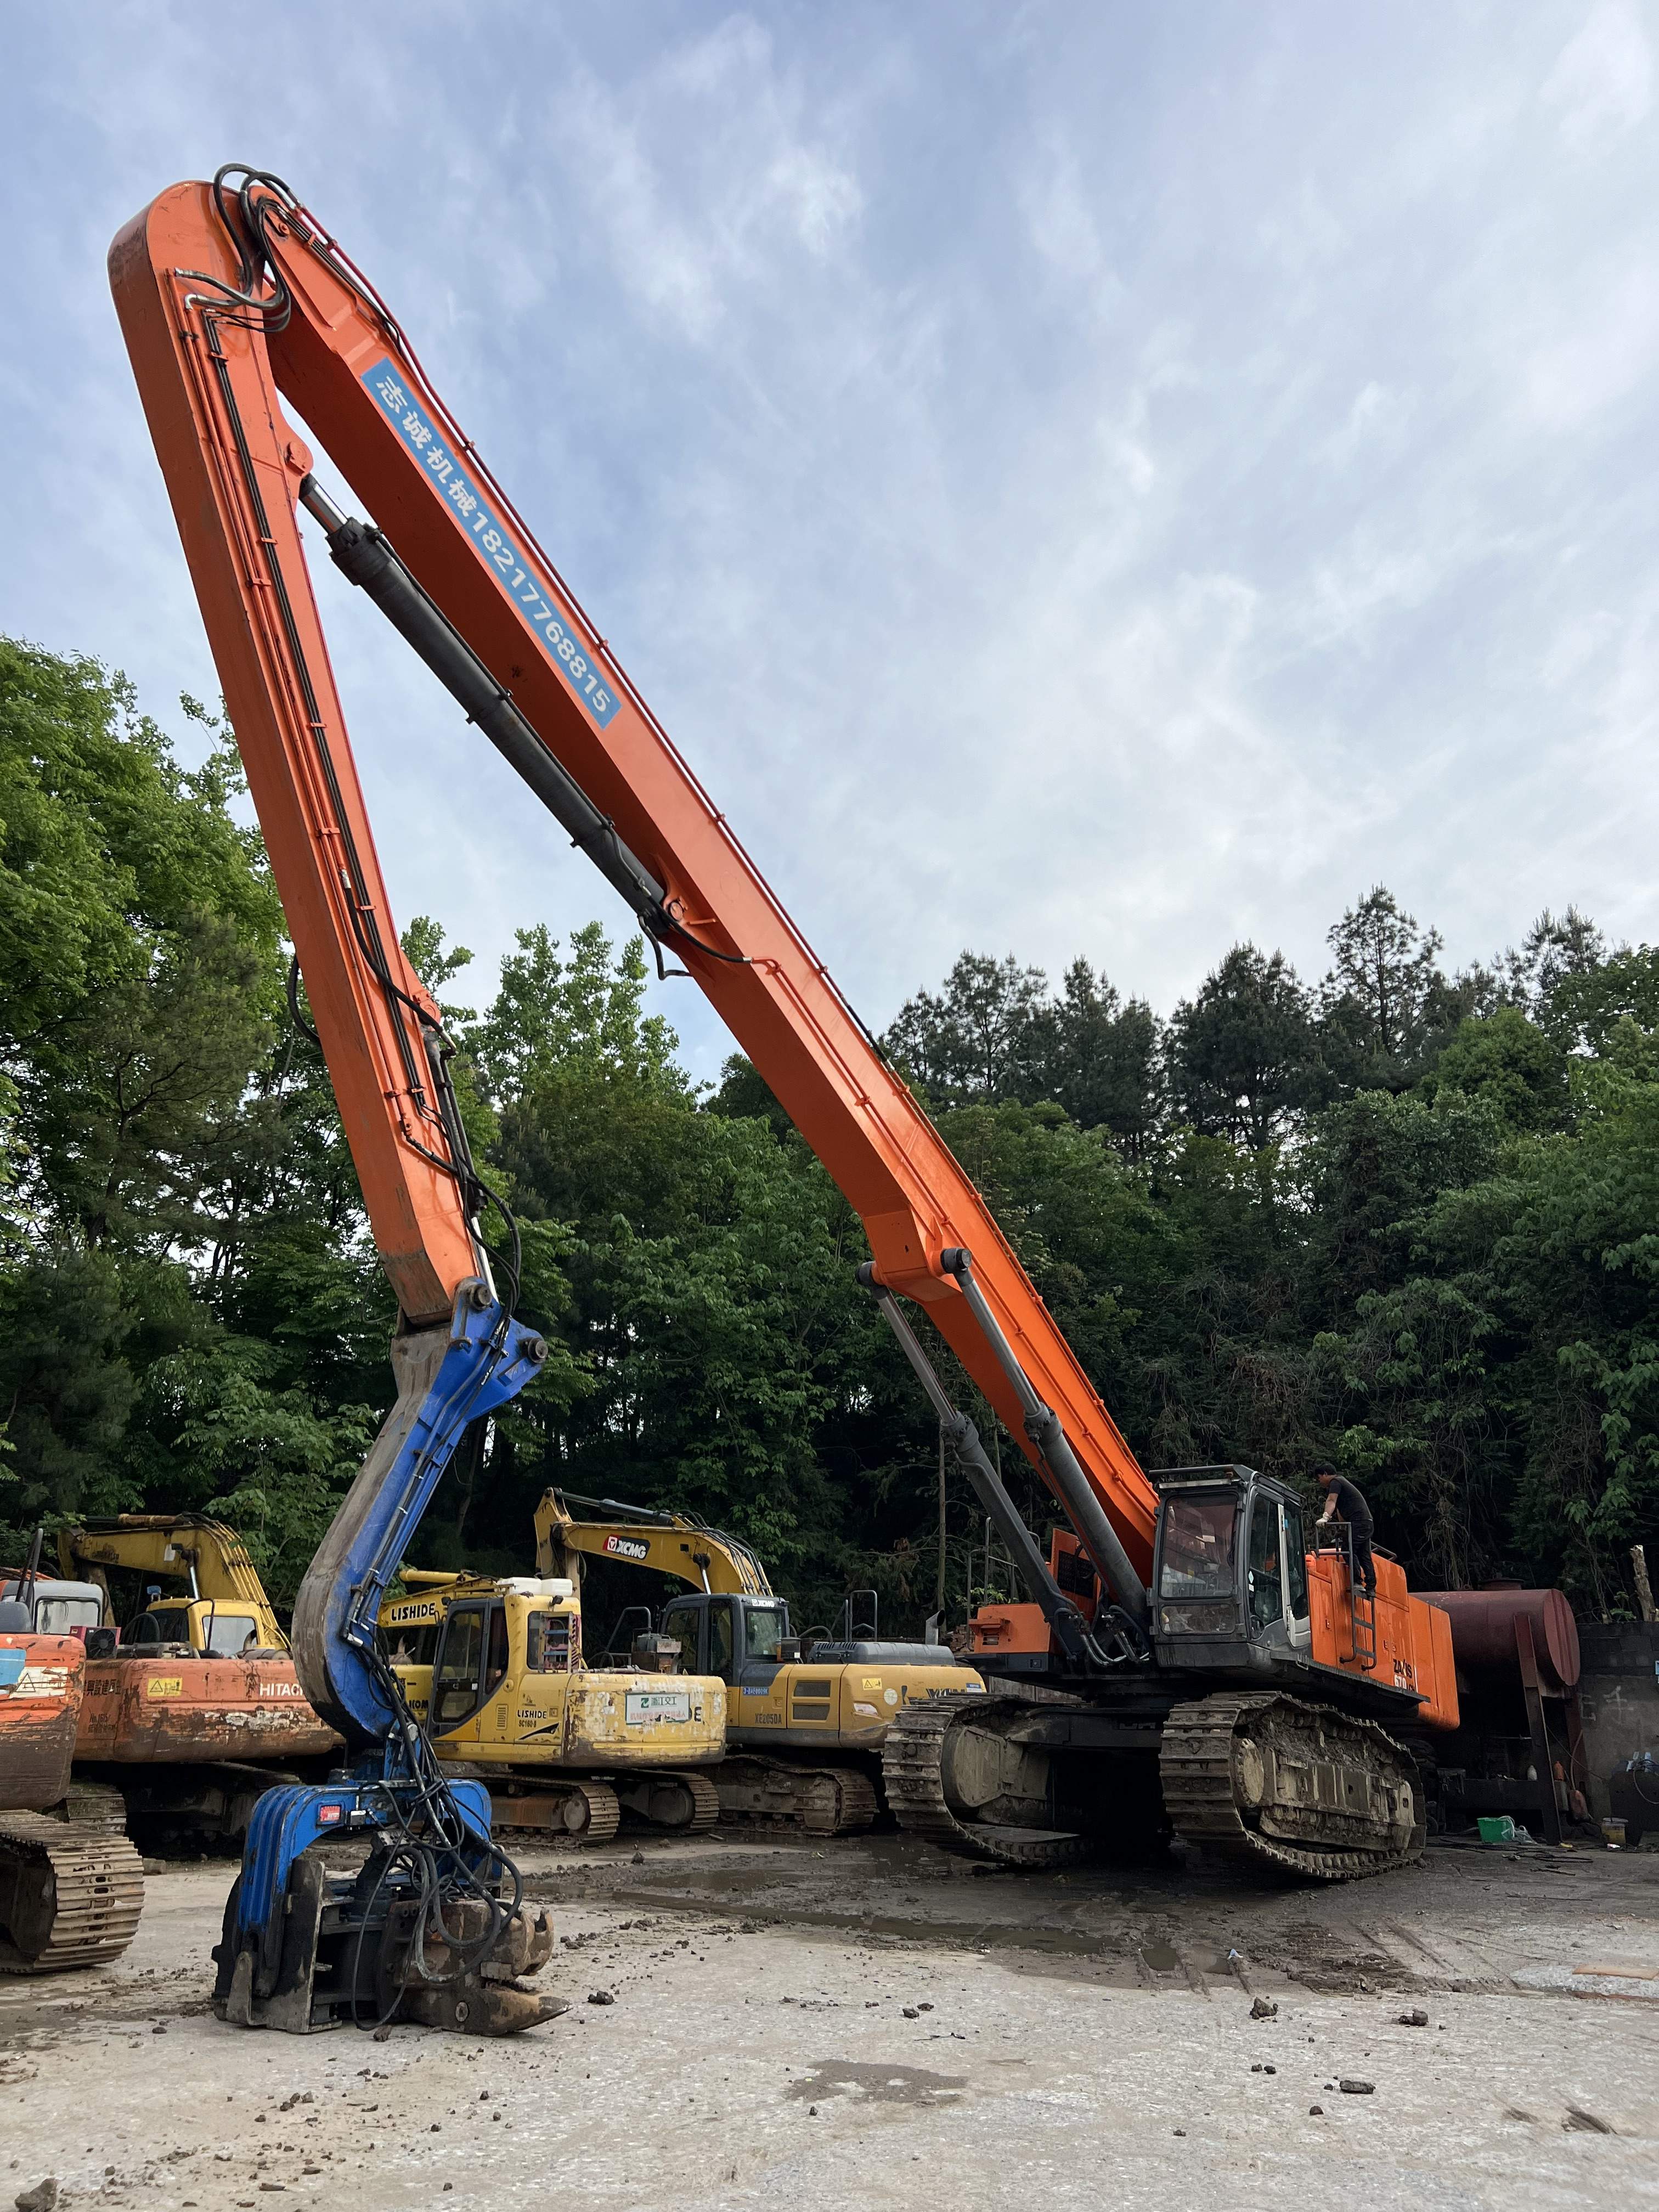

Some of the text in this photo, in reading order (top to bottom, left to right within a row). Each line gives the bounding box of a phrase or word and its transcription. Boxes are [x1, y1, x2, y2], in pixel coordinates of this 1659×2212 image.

[616, 1540, 646, 1559] XCMG
[391, 1602, 436, 1621] LISHIDE
[517, 1709, 548, 1719] LISHIDE
[755, 1713, 782, 1724] XE205DA
